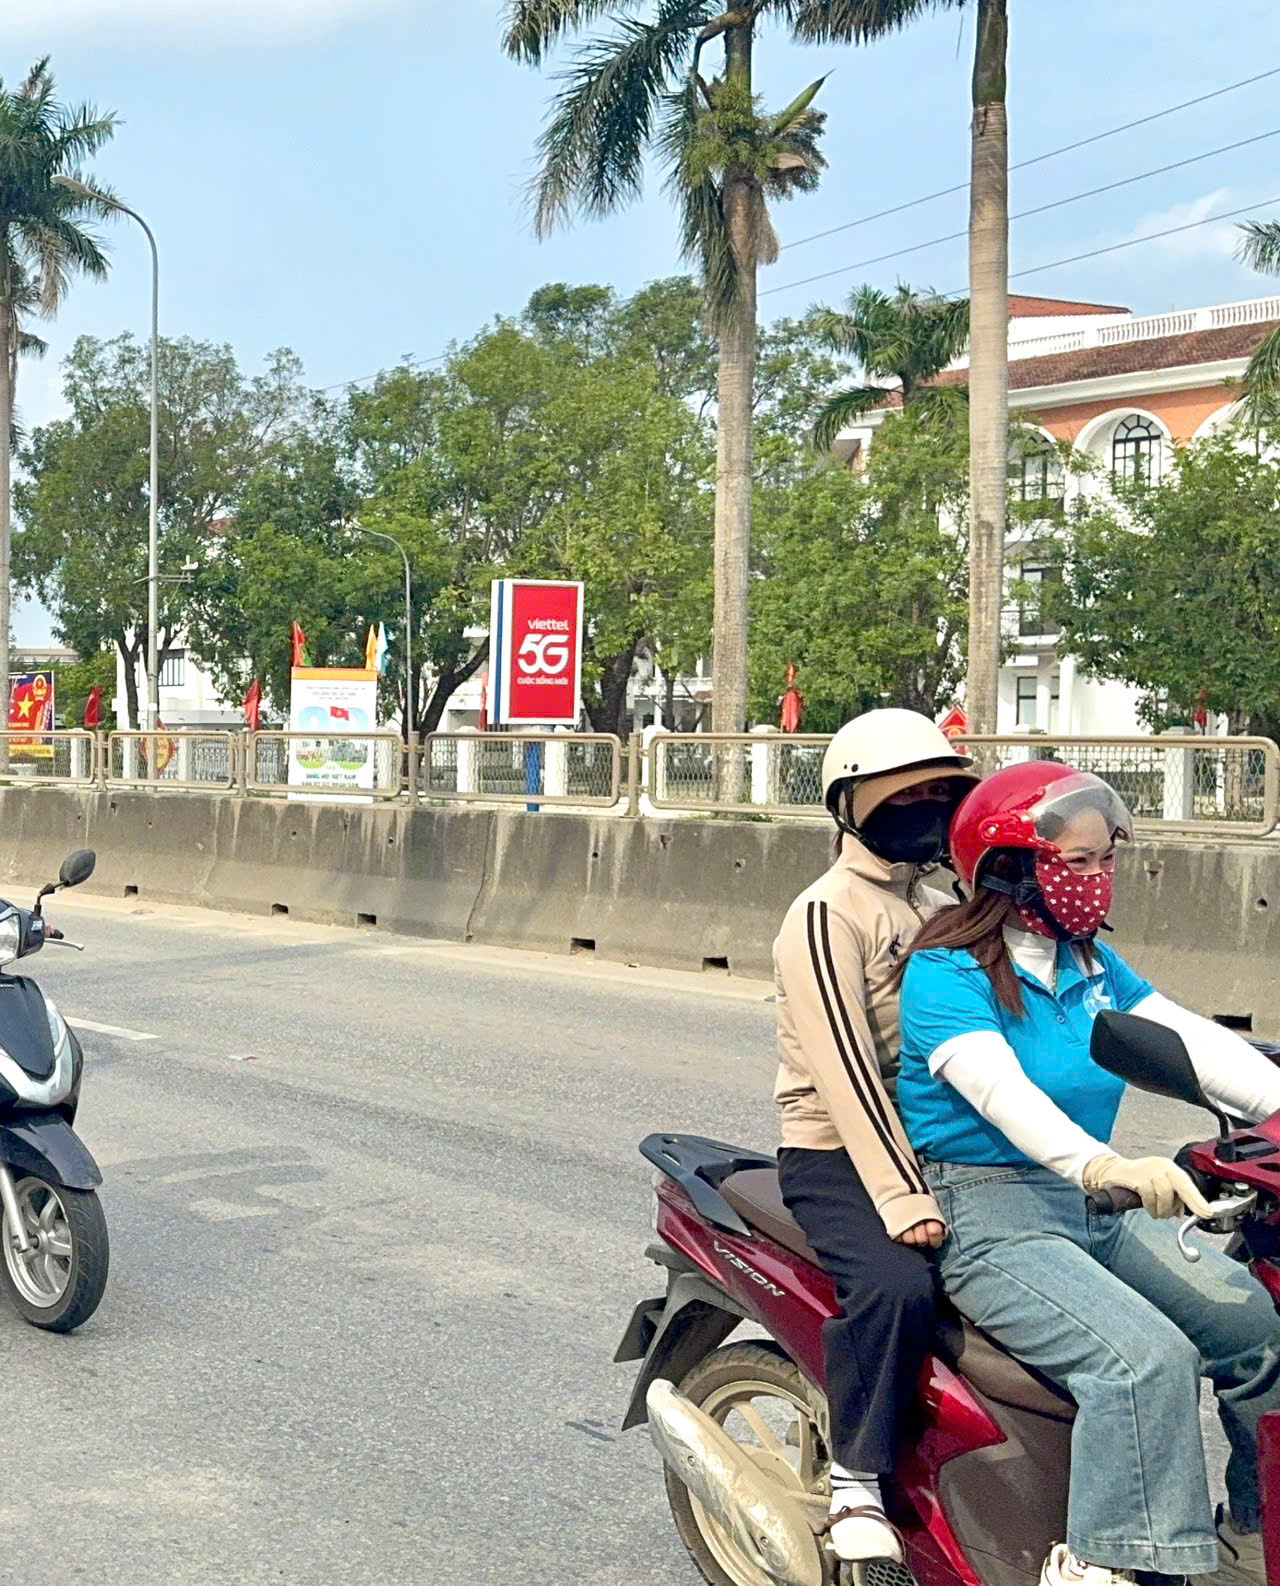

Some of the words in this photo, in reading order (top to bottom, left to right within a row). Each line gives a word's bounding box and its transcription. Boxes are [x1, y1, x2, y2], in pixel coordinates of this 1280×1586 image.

[527, 618, 569, 631] viettel
[517, 633, 569, 674] 5G
[713, 1240, 785, 1297] VISION
